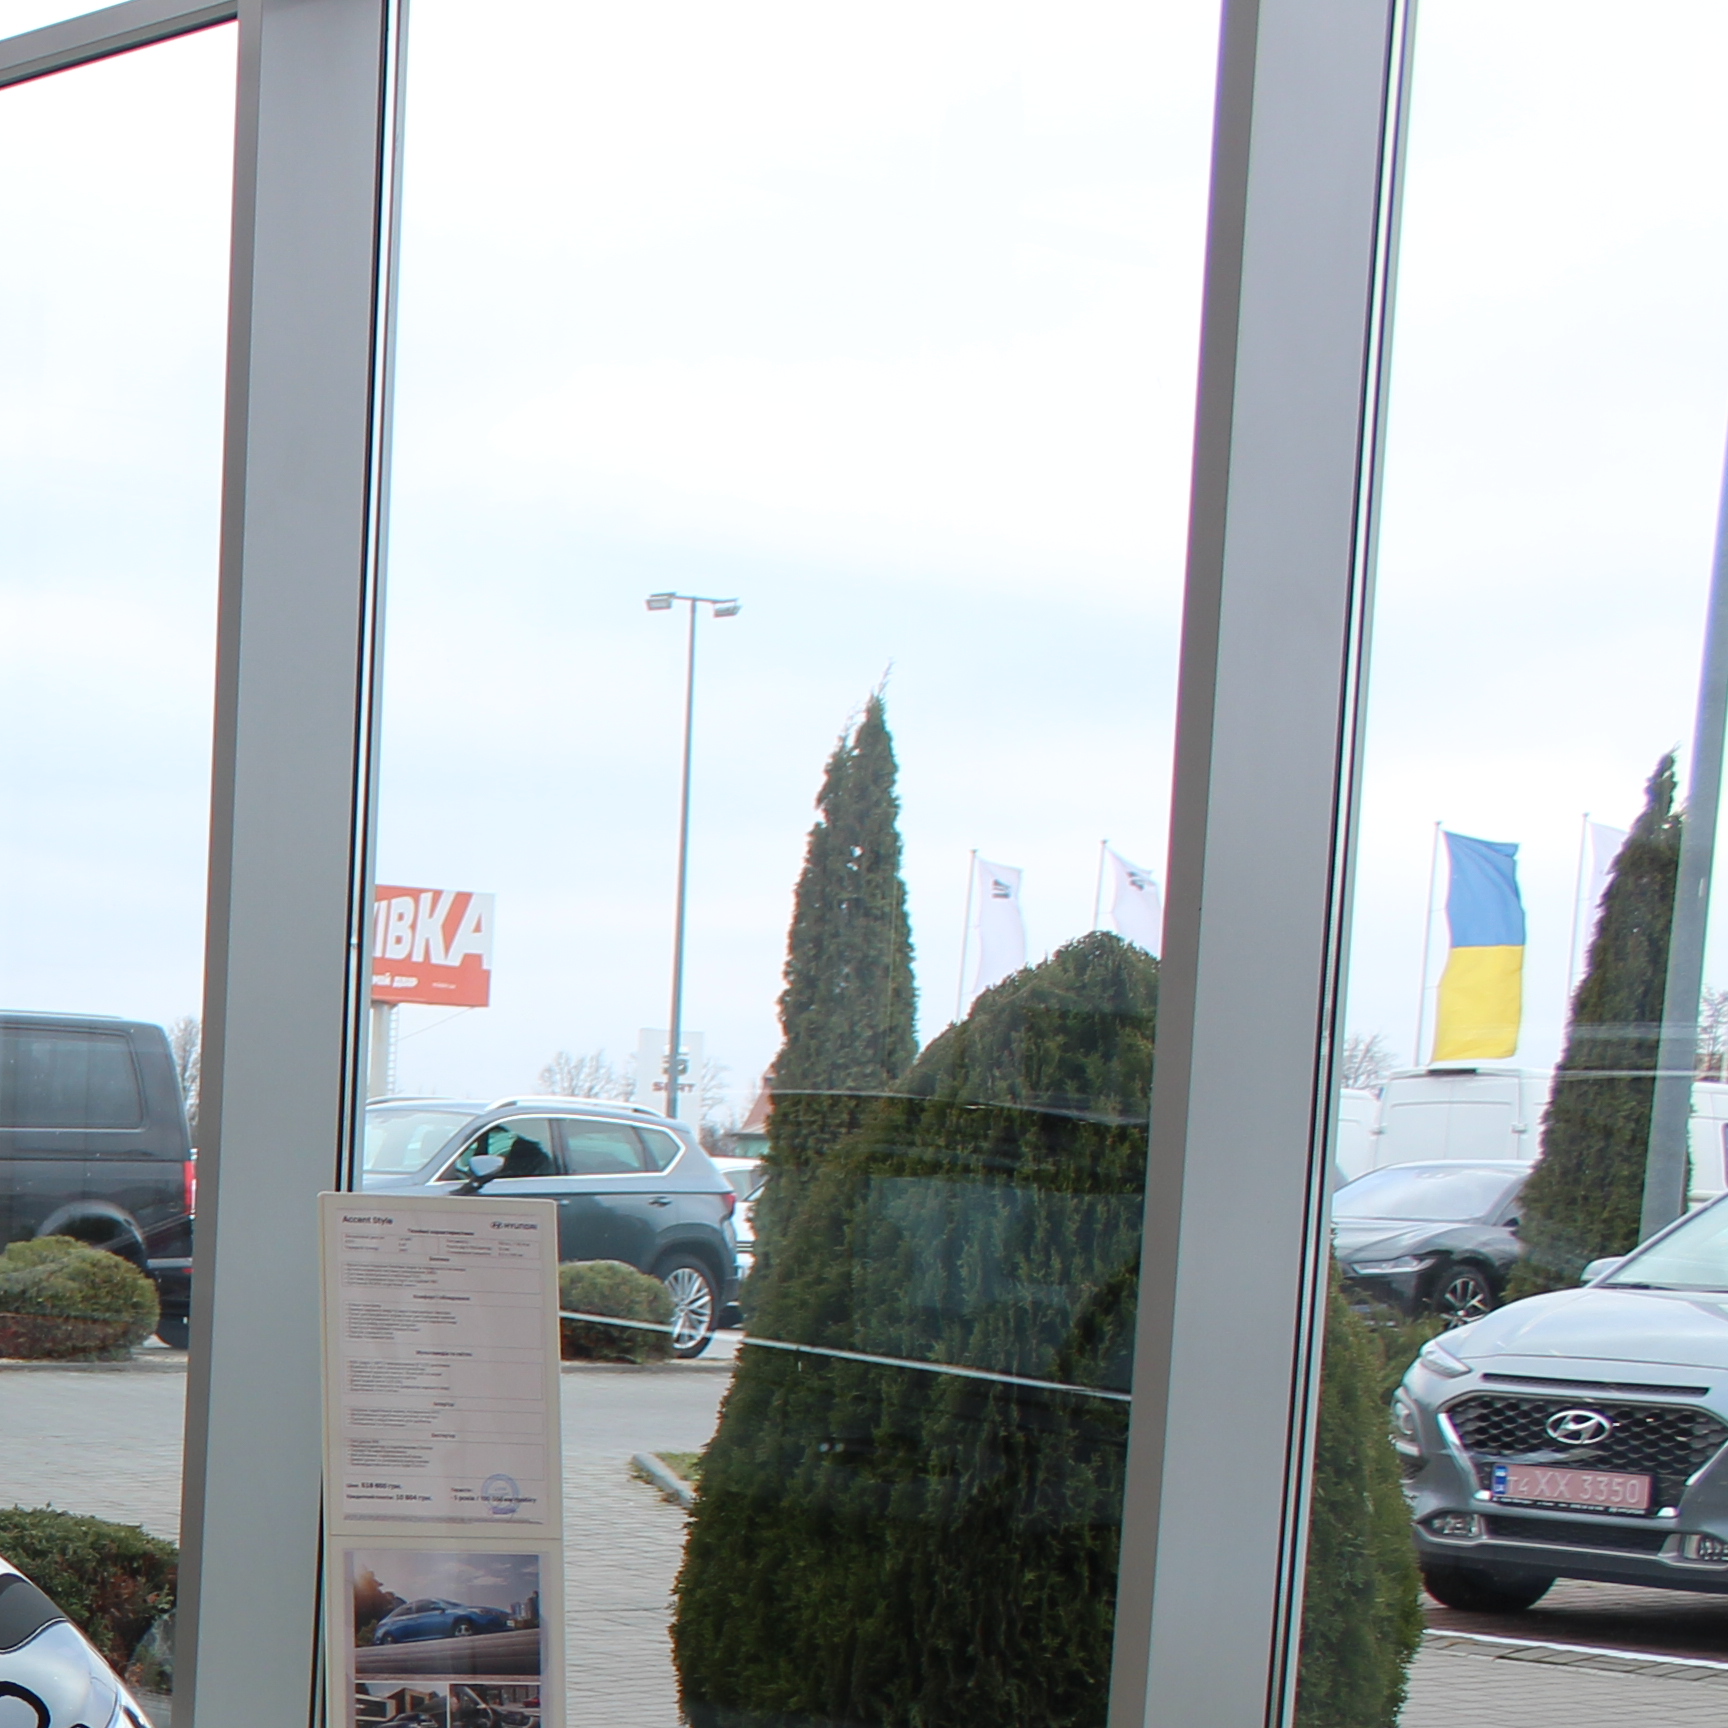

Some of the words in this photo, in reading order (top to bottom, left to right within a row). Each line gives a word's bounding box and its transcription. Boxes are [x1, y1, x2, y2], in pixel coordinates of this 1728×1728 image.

[342, 1215, 371, 1224] Accent
[373, 1216, 394, 1226] Style
[1578, 1475, 1640, 1504] 3350
